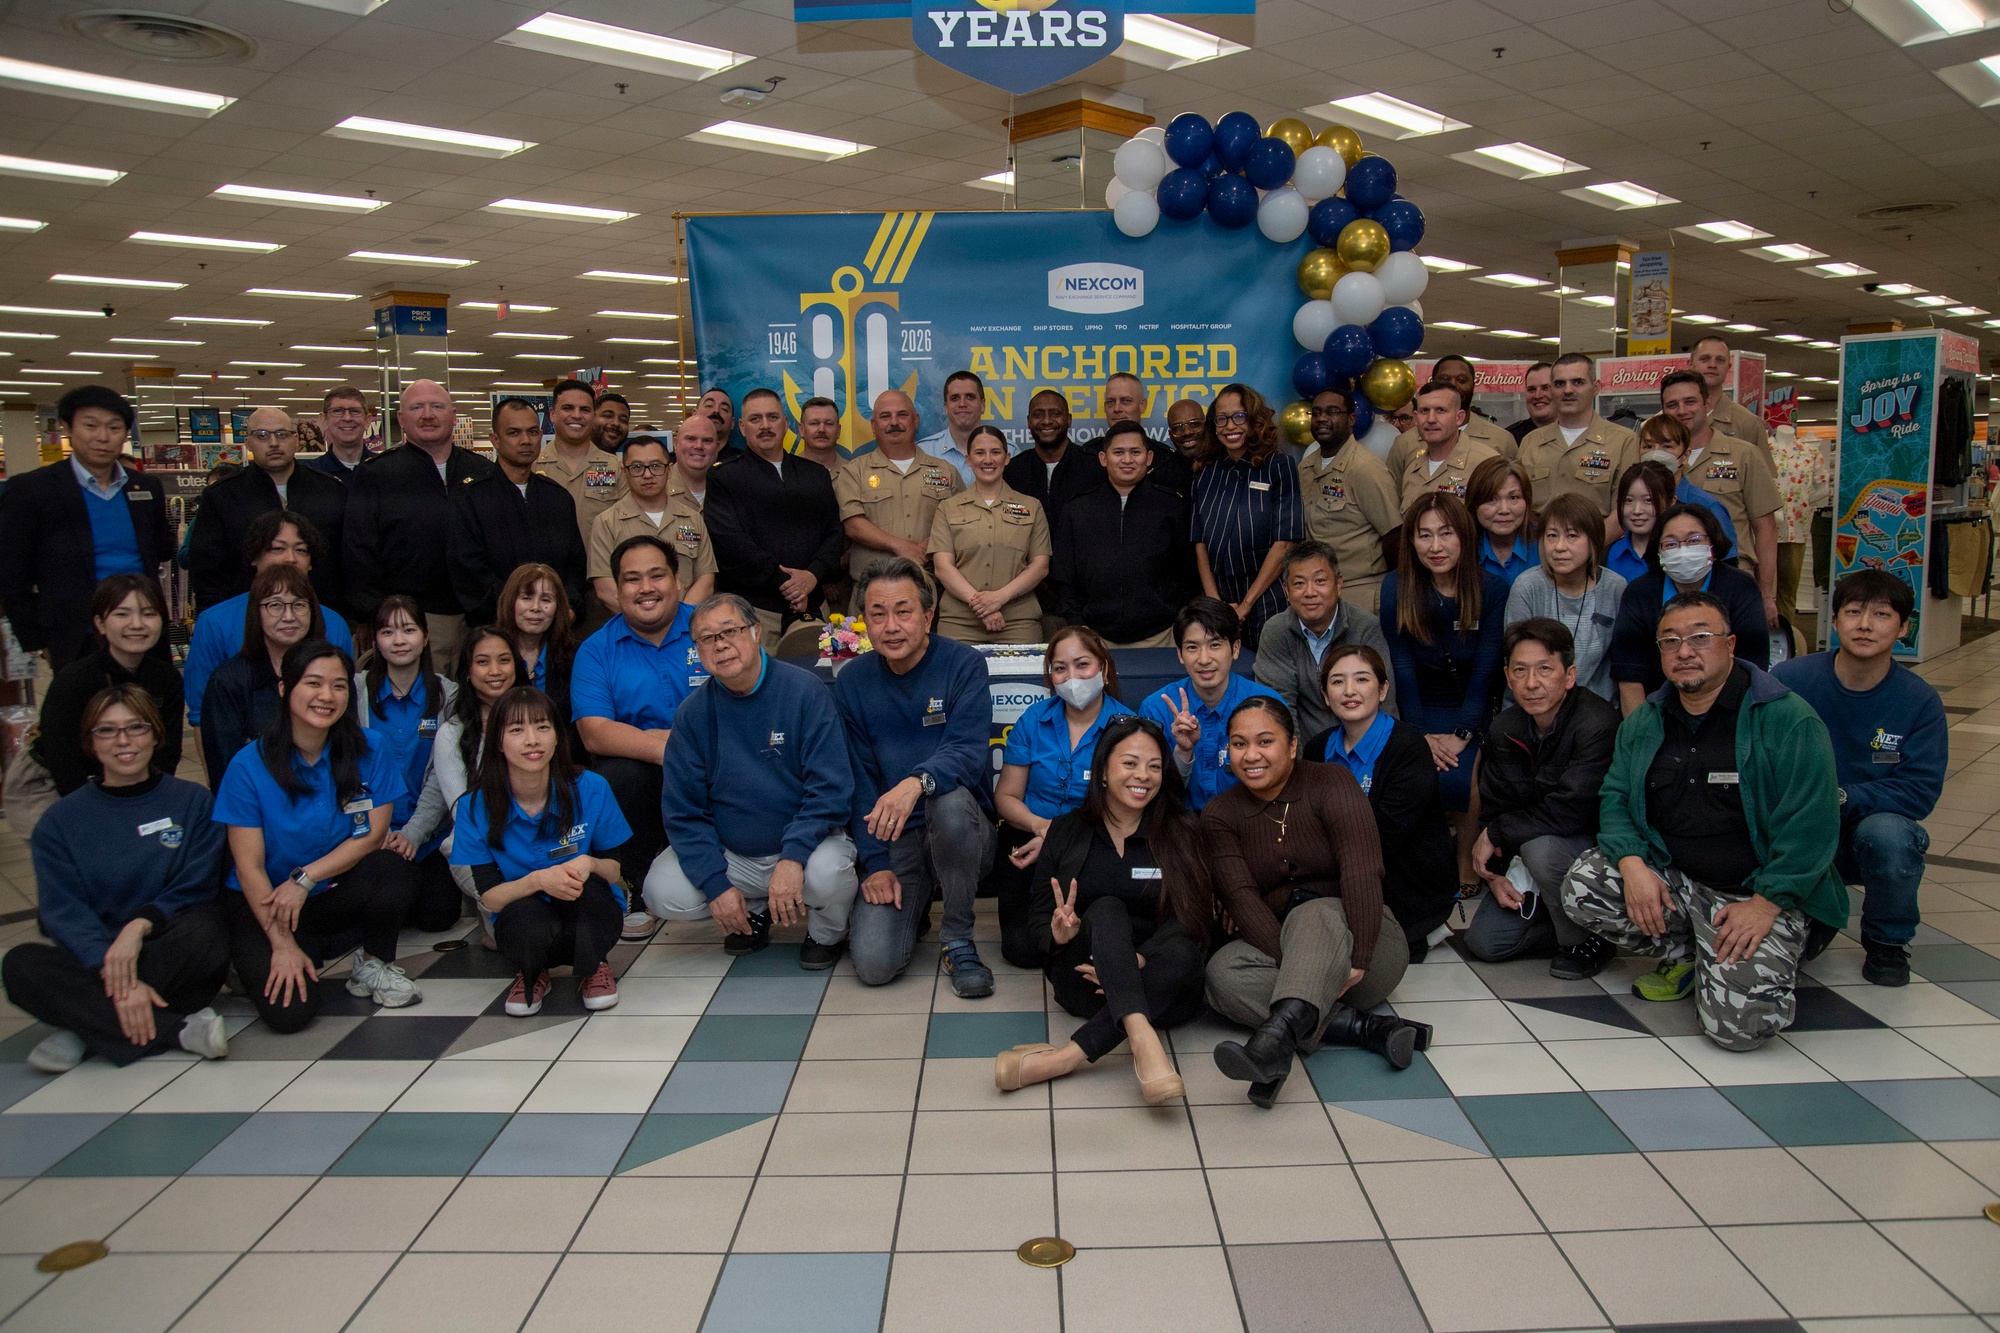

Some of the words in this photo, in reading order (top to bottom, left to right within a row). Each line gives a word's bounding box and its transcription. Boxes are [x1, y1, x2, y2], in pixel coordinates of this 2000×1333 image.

[928, 11, 1107, 47] YEARS
[1066, 278, 1136, 290] NEXCOM
[768, 332, 797, 354] 1946
[902, 330, 932, 352] 2026
[970, 344, 1237, 380] ANCHORED
[1474, 372, 1523, 386] Fashion
[1612, 368, 1660, 386] Spring
[1861, 376, 1900, 394] Spring
[1902, 373, 1912, 382] is
[1913, 372, 1922, 380] a
[1763, 386, 1792, 406] JOY
[1851, 386, 1918, 428] JOY
[1891, 422, 1920, 438] Ride
[176, 476, 207, 487] totes
